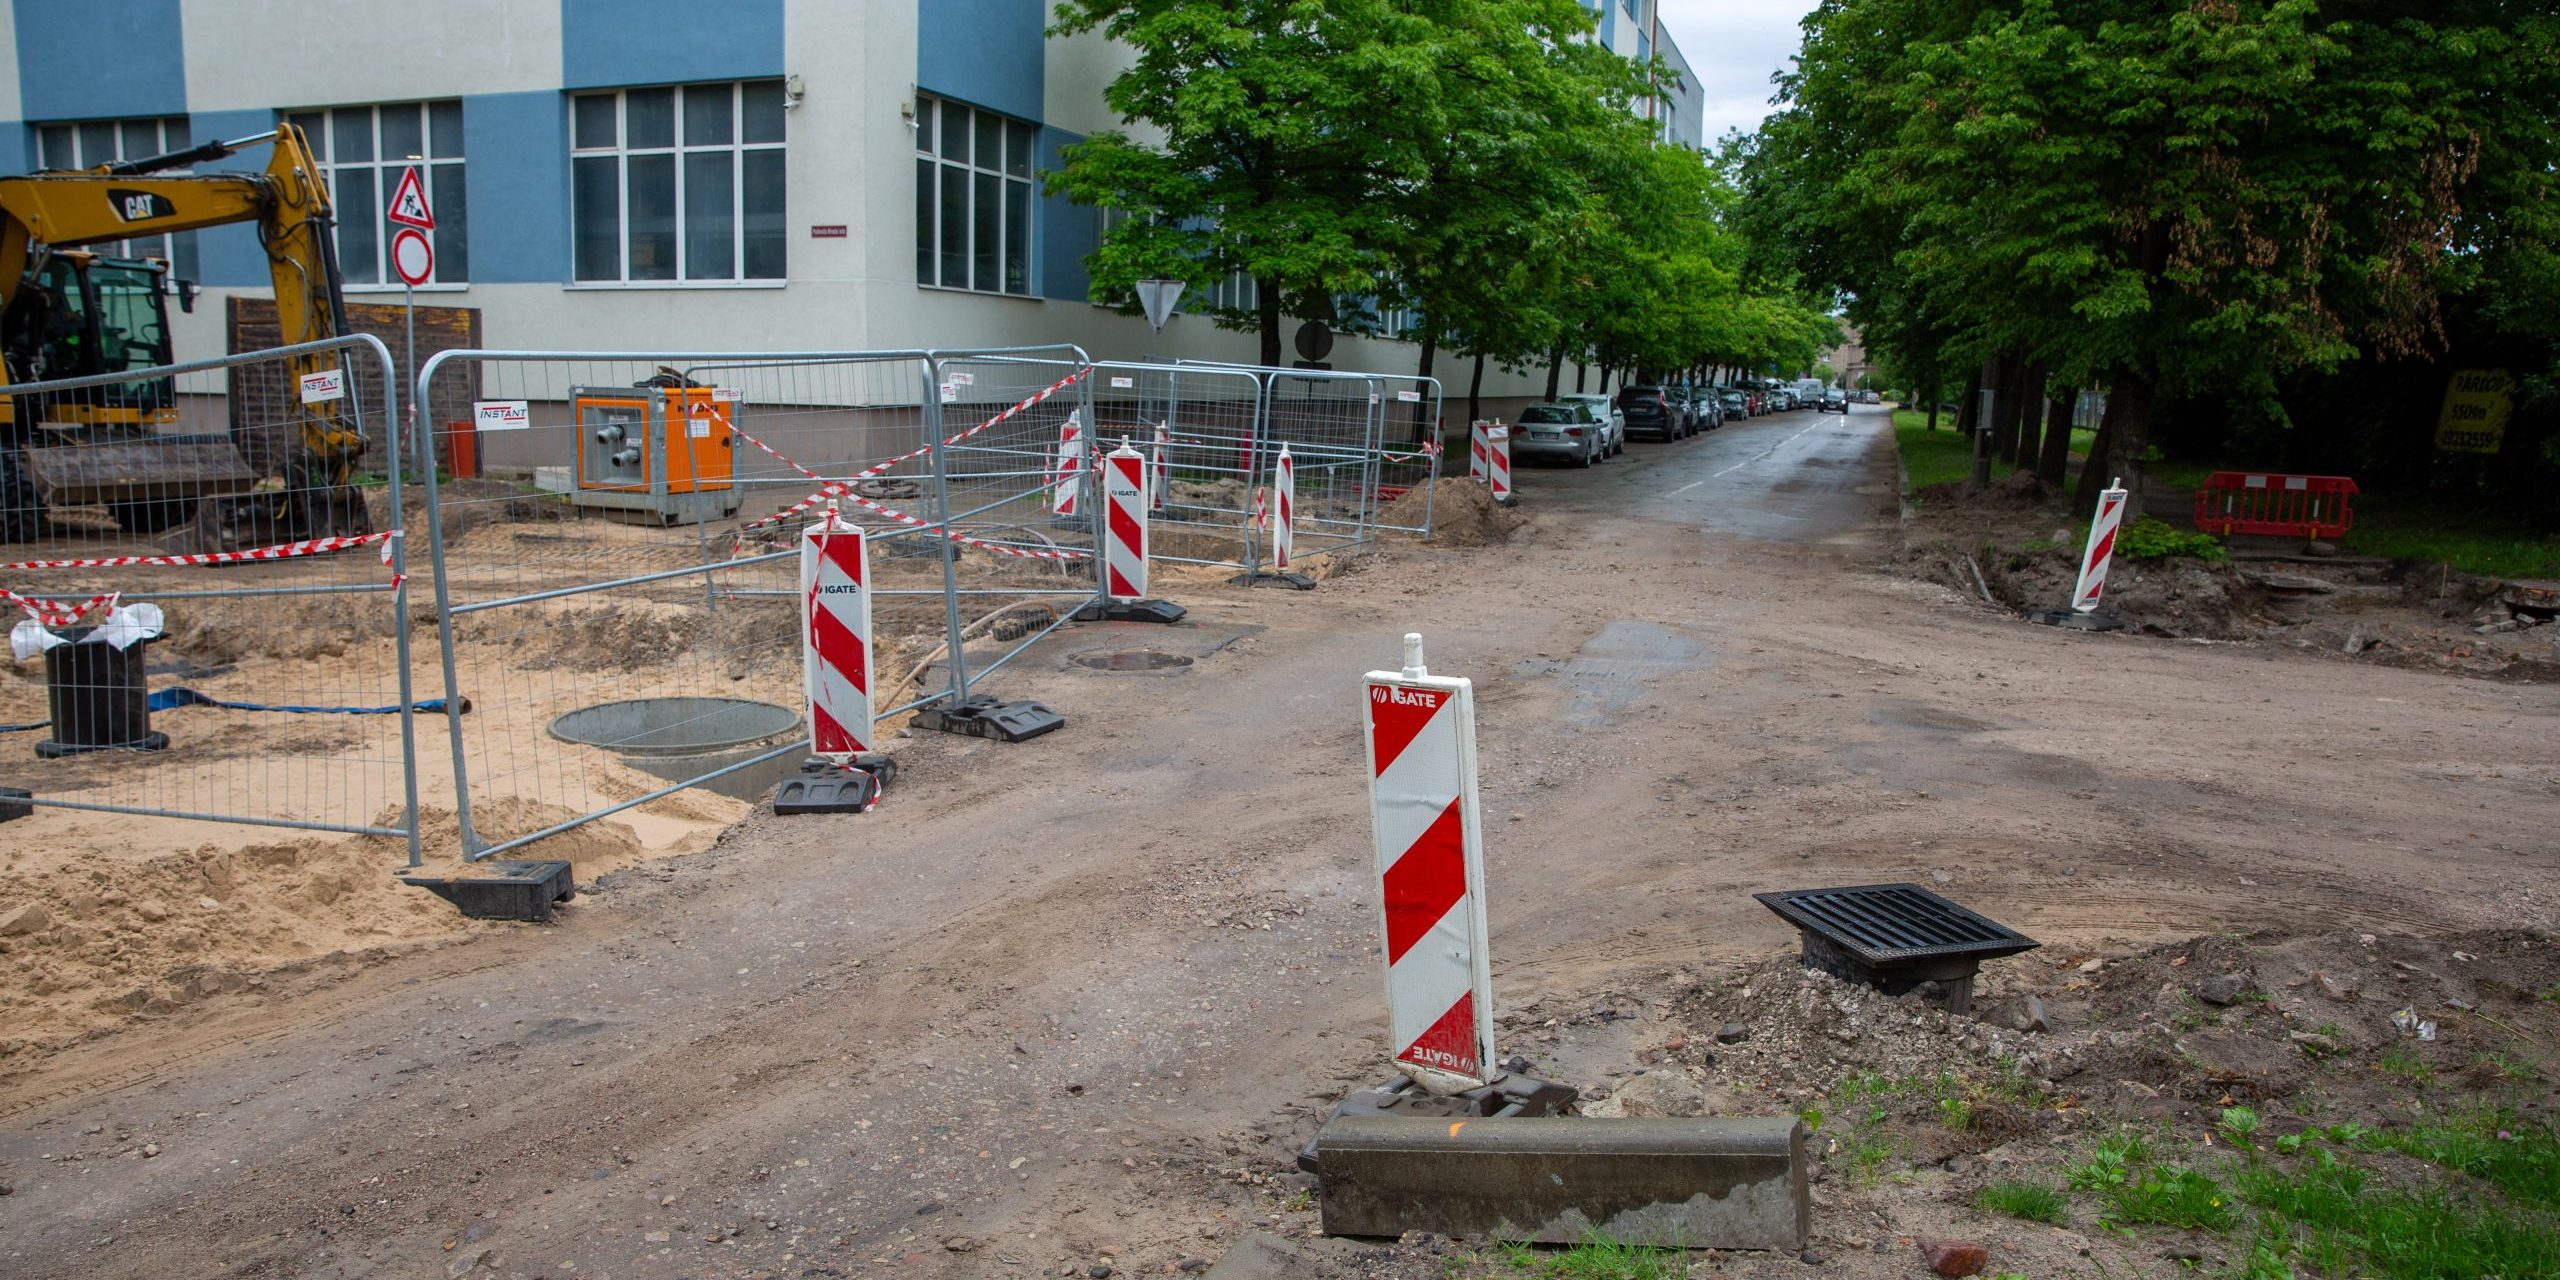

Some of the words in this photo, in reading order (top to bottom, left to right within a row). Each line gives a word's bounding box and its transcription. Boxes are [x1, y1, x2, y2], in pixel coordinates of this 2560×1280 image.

[125, 194, 153, 220] CAT
[302, 378, 339, 391] INSTANT
[480, 409, 526, 419] INSTANT
[825, 585, 856, 594] IGATE
[1413, 1046, 1458, 1068] IGATE
